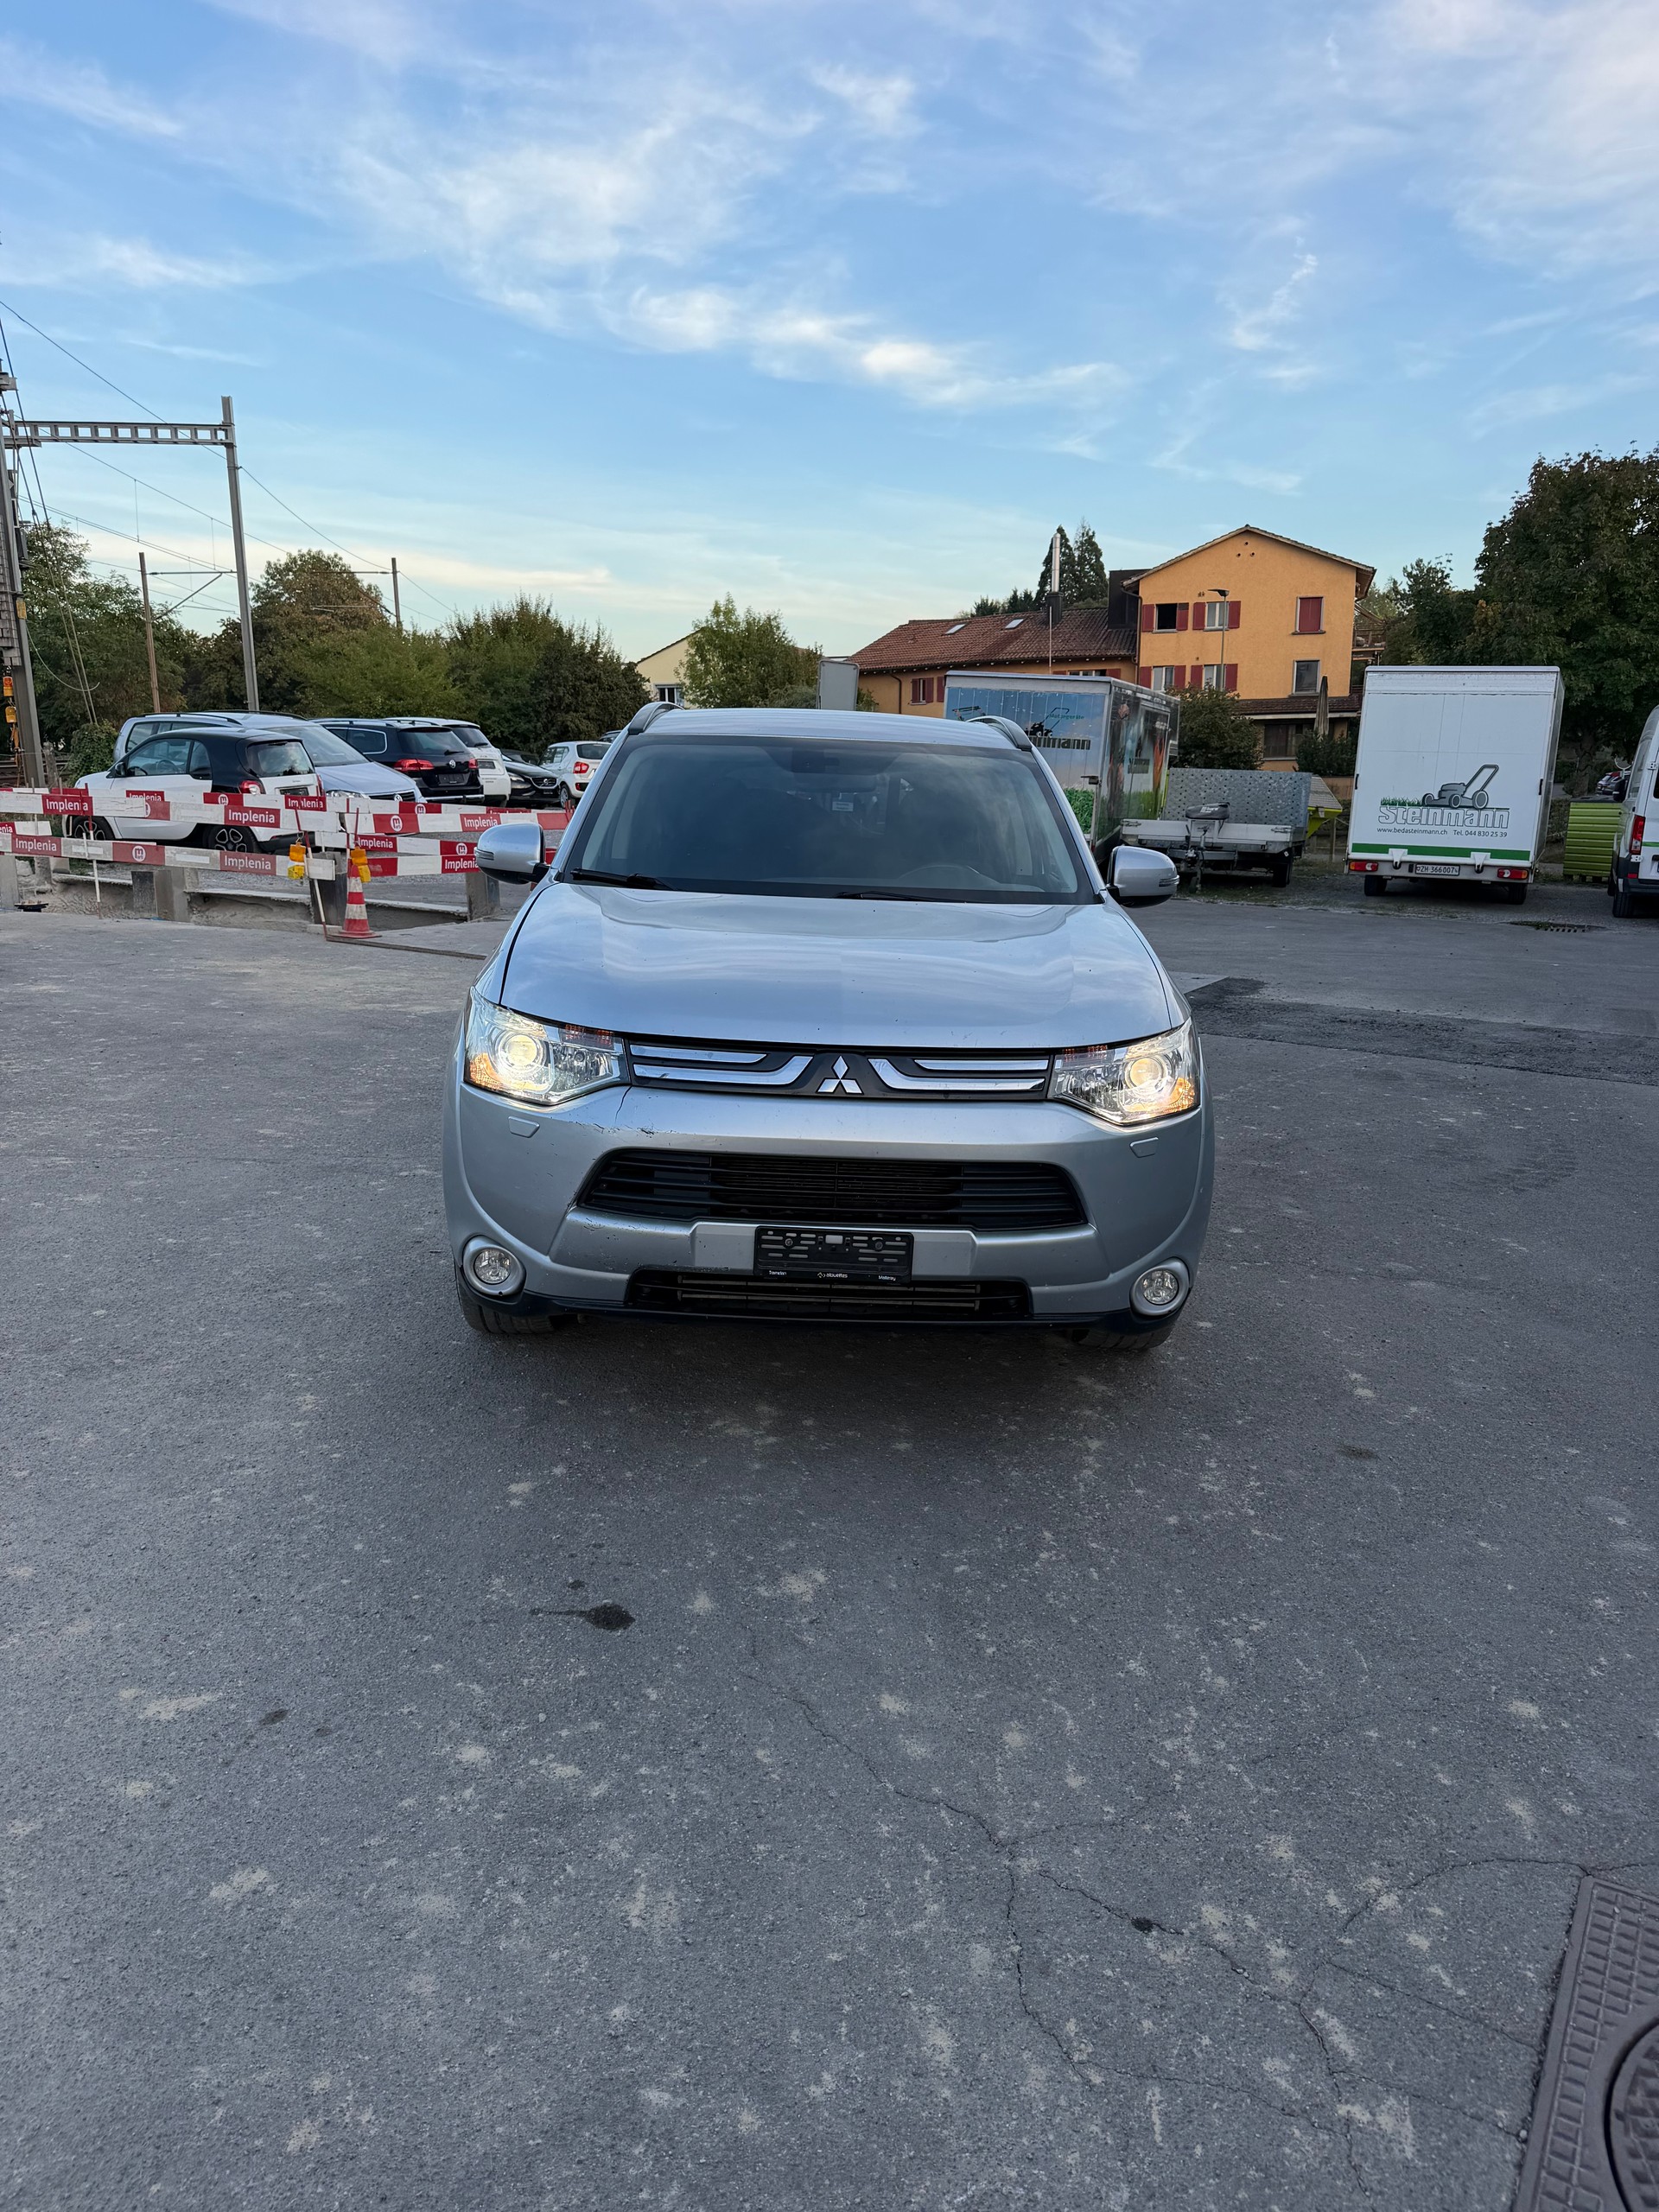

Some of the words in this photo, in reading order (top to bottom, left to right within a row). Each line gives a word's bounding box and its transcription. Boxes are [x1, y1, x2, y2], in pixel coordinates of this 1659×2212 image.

[228, 810, 276, 823] Implenia
[464, 817, 498, 827] Implenia
[1378, 805, 1510, 829] Steinmann
[1376, 827, 1448, 836] www.bedasteinmann.ch
[16, 838, 57, 852] Implenia
[358, 837, 394, 849] Implenia
[225, 855, 271, 870] Implenia
